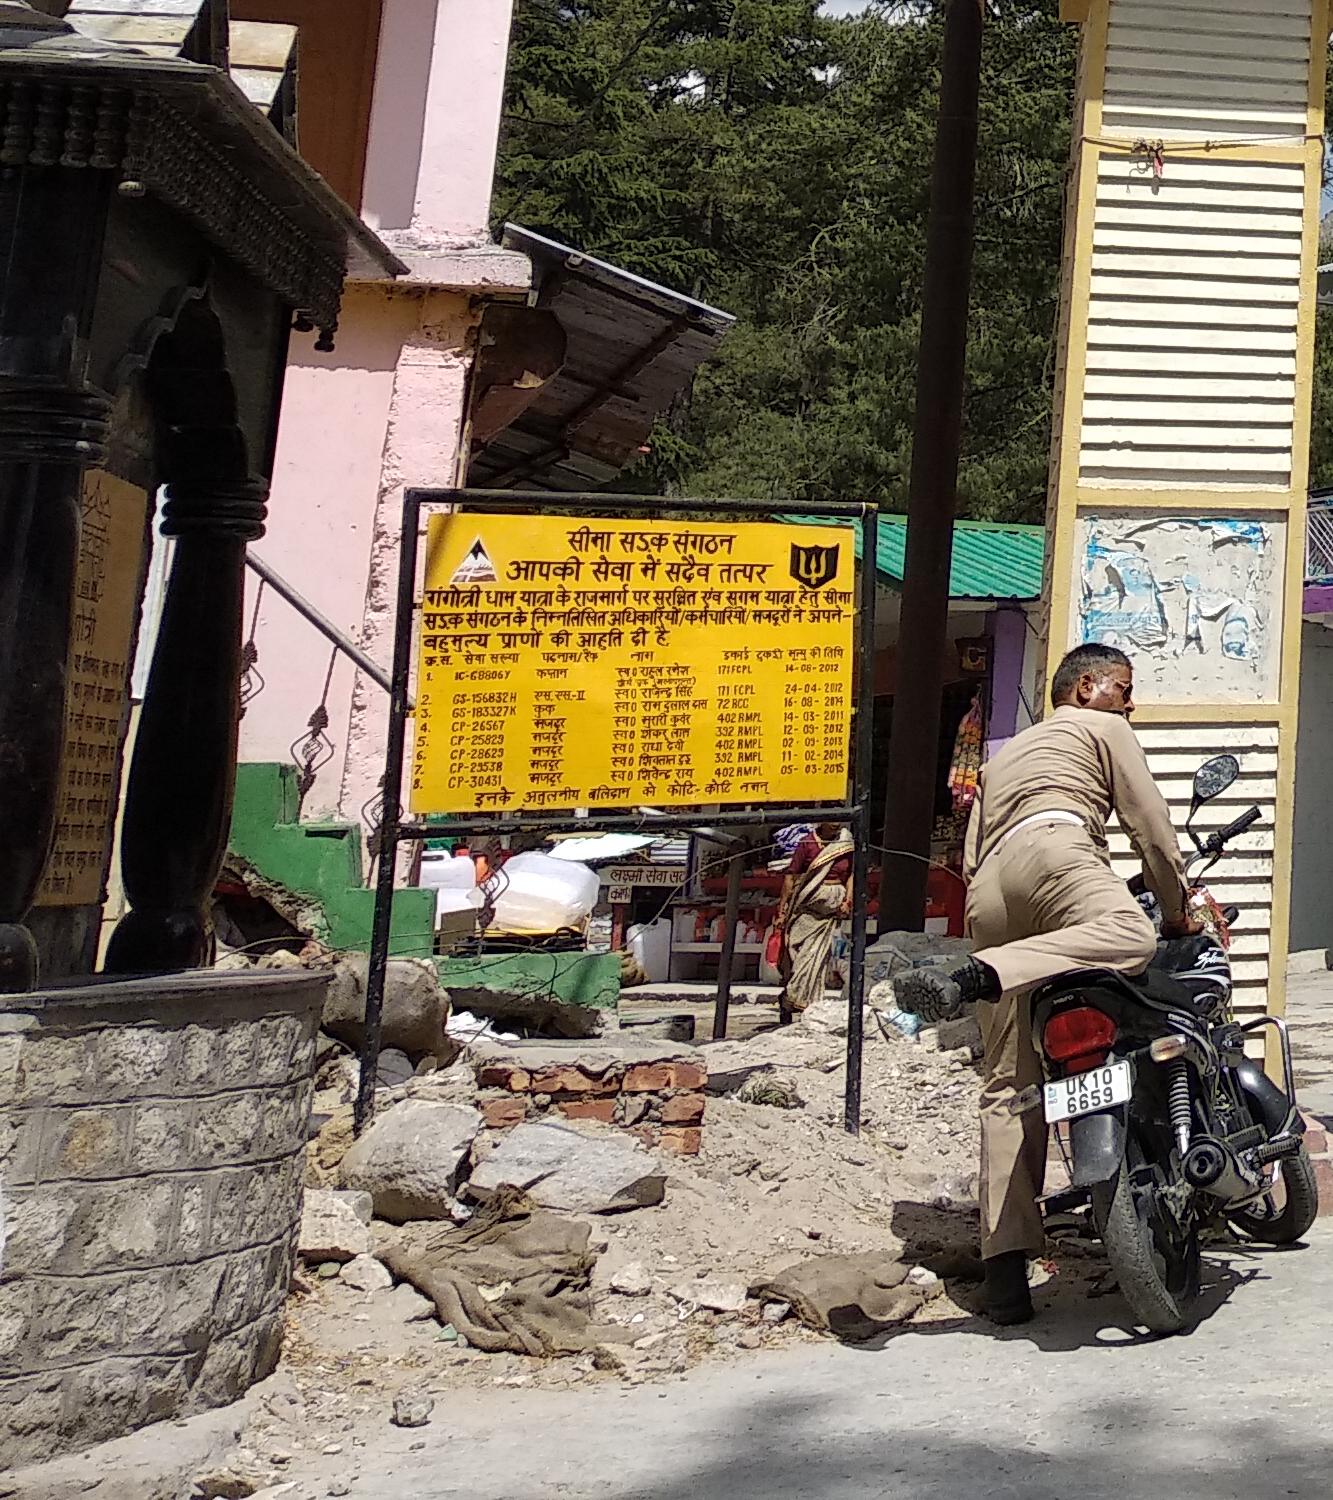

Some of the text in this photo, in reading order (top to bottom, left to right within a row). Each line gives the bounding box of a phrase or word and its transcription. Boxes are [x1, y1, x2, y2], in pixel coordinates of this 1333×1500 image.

[566, 526, 615, 552] सीमा
[673, 530, 737, 554] संगठन
[506, 554, 774, 583] आपकी सेवा में सदैव तत्पर
[425, 584, 483, 608] गंगोत्री
[485, 590, 517, 607] धाम
[520, 590, 555, 607] यात्रा
[556, 584, 572, 607] के
[574, 583, 629, 607] राजमार्ग
[632, 590, 651, 606] पर
[765, 590, 797, 606] यात्रा
[799, 585, 821, 608] हेतु
[466, 609, 514, 628] संगठन
[514, 606, 528, 627] के
[793, 605, 807, 623] ने
[497, 628, 543, 649] प्राणों
[549, 630, 573, 647] की
[576, 628, 624, 650] आहुति
[630, 627, 650, 647] दी
[462, 650, 487, 665] सेवा
[810, 647, 821, 659] की
[420, 722, 430, 732] 4.
[452, 720, 505, 732] CP-26567
[717, 712, 736, 723] 402
[417, 736, 429, 747] 5.
[417, 750, 427, 760] 6.
[715, 739, 734, 750] 402
[413, 778, 423, 789] 8.
[448, 775, 501, 788] CP-30431
[715, 767, 734, 777] 402
[415, 764, 425, 775] 7.
[475, 786, 515, 808] इनके
[524, 787, 580, 805] अतुलनीय
[588, 784, 630, 800] बलिदान
[642, 782, 657, 797] को
[1067, 1087, 1113, 1113] 6659
